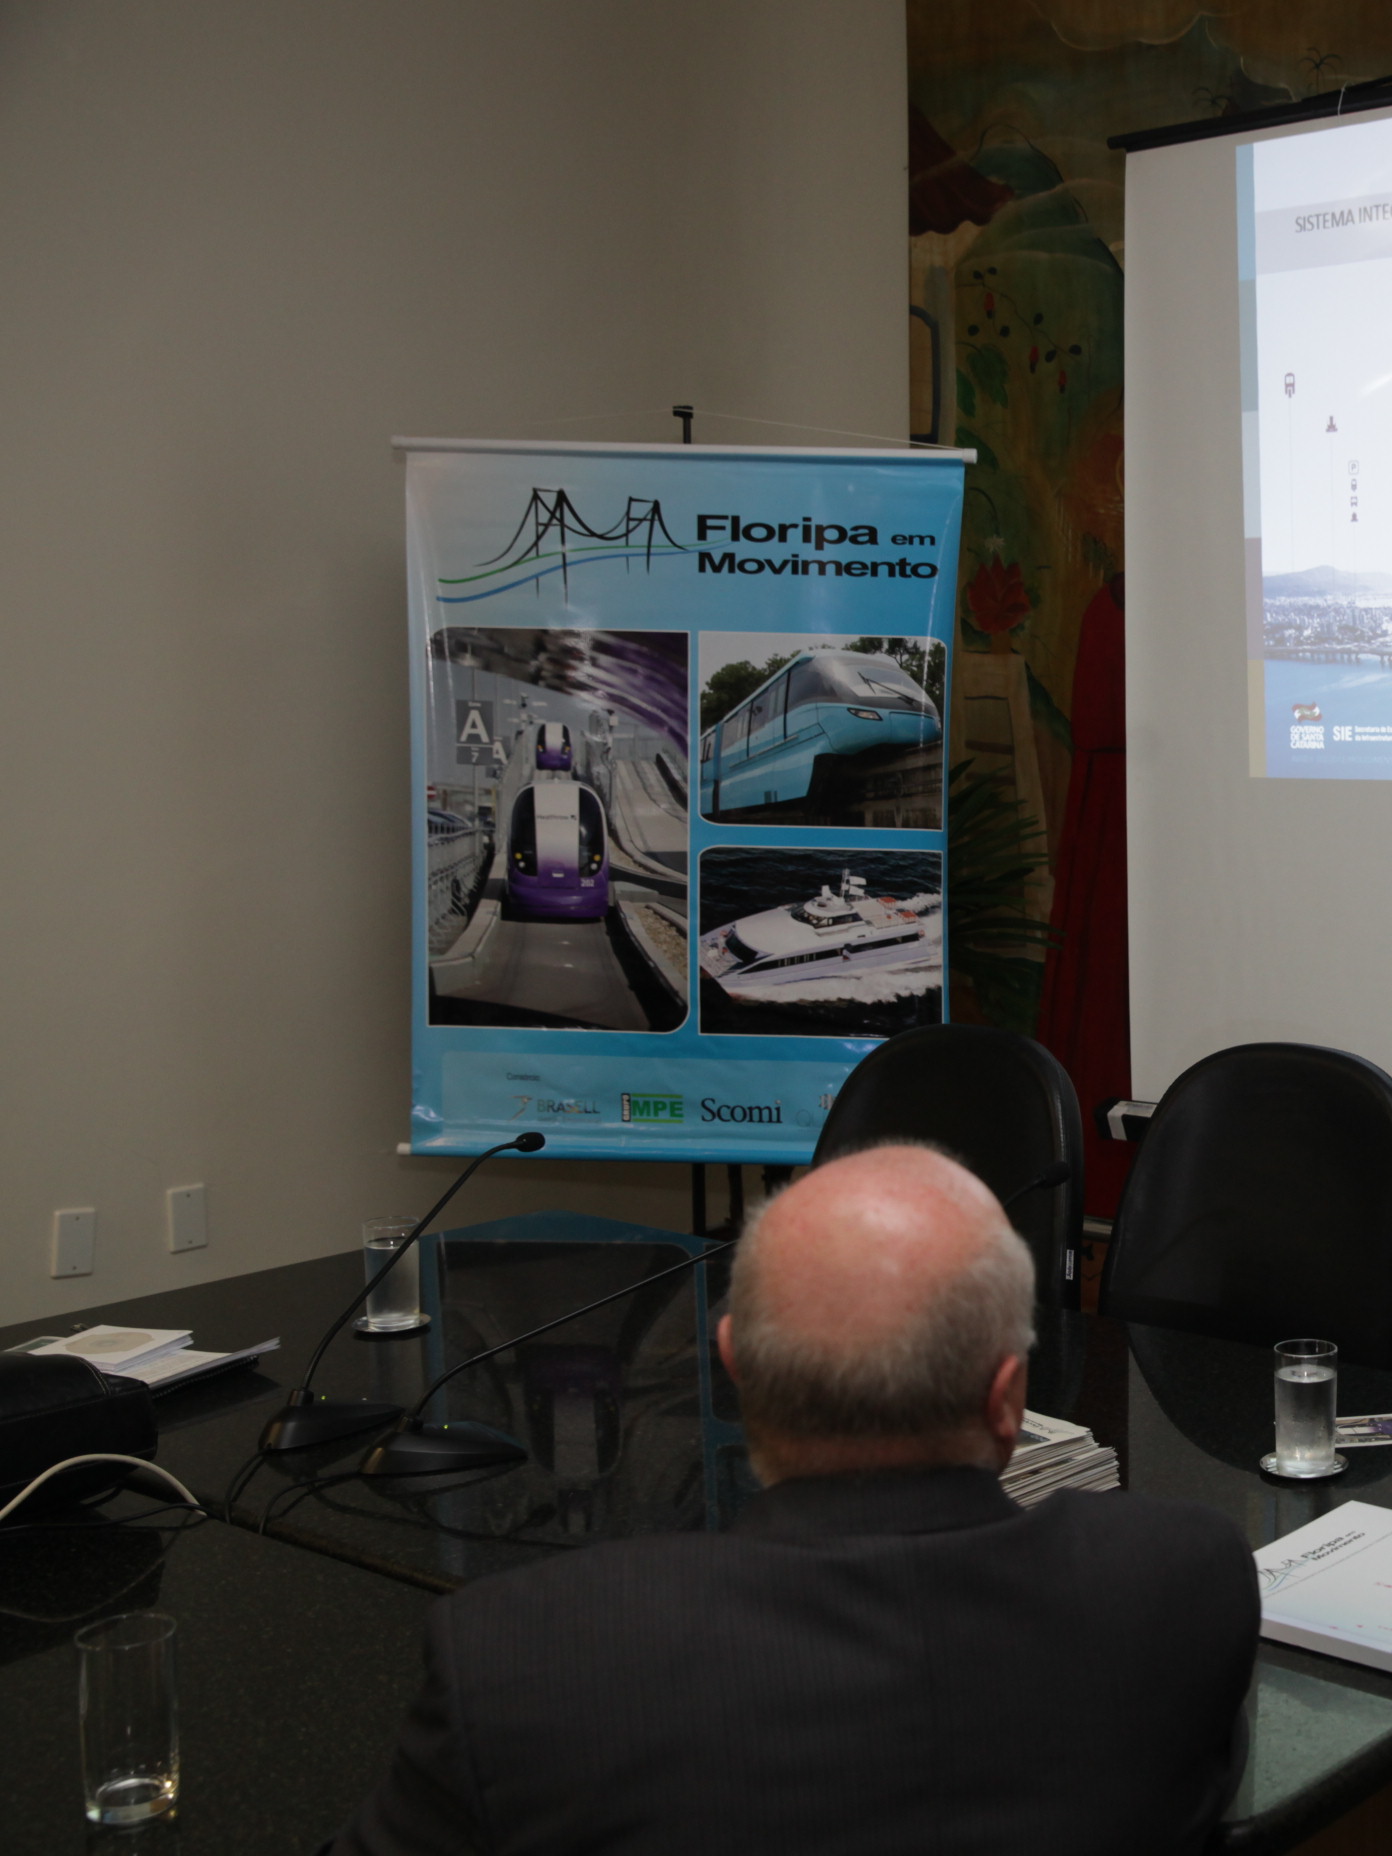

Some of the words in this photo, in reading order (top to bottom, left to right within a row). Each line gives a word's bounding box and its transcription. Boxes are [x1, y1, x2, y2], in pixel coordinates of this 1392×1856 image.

[1295, 210, 1355, 233] SISTEMA
[697, 514, 879, 550] Floripa
[890, 532, 936, 546] em
[698, 551, 939, 579] Movimento
[459, 709, 490, 743] A
[1290, 725, 1325, 734] GOVERNO
[1333, 726, 1353, 742] SIE
[1290, 734, 1301, 742] DE
[1302, 734, 1324, 742] SANTA
[1290, 741, 1325, 750] CATARINA
[631, 1100, 684, 1119] MPE
[701, 1097, 782, 1124] Scomi
